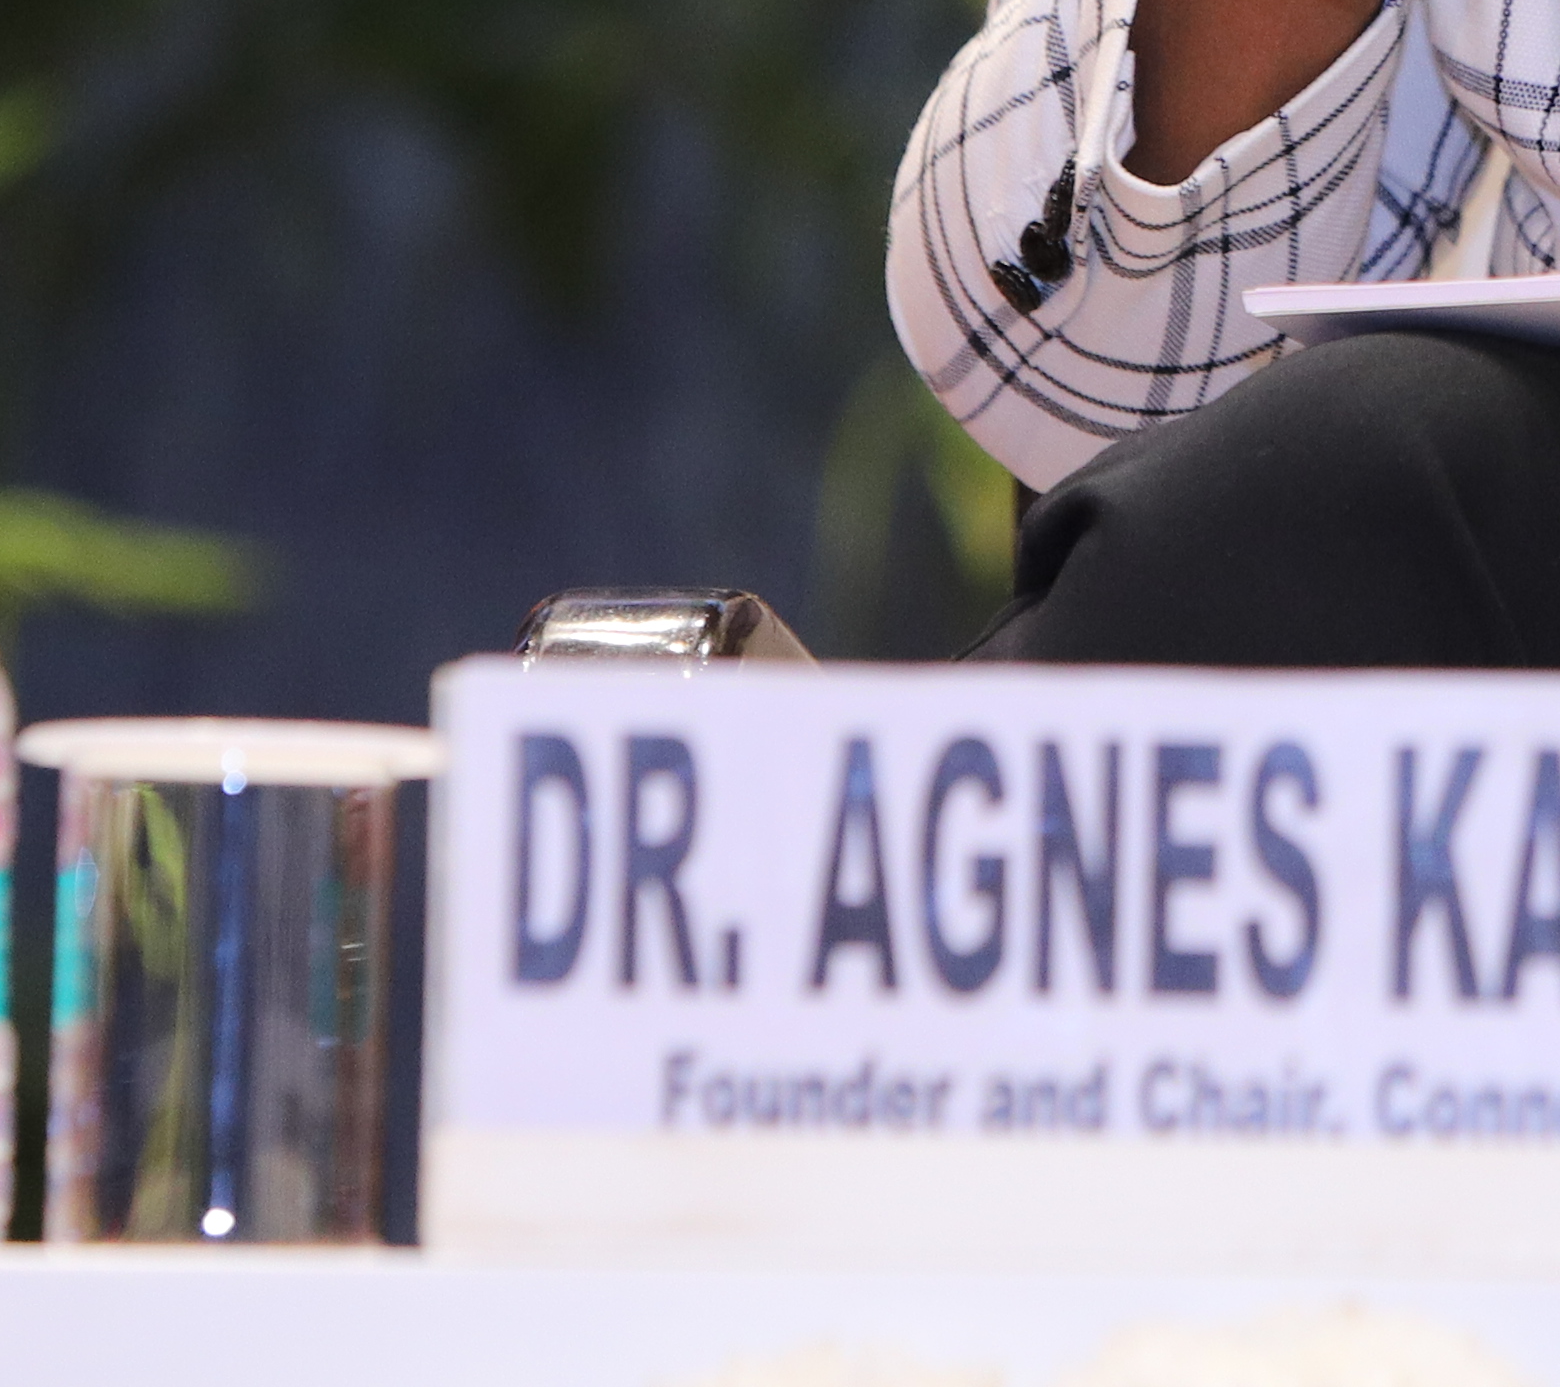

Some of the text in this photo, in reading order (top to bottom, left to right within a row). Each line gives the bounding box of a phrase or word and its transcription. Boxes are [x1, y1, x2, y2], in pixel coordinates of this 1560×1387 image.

[512, 731, 742, 989] DR.
[808, 734, 1322, 1003] AGNES
[659, 1046, 953, 1131] Founder
[981, 1061, 1109, 1134] and
